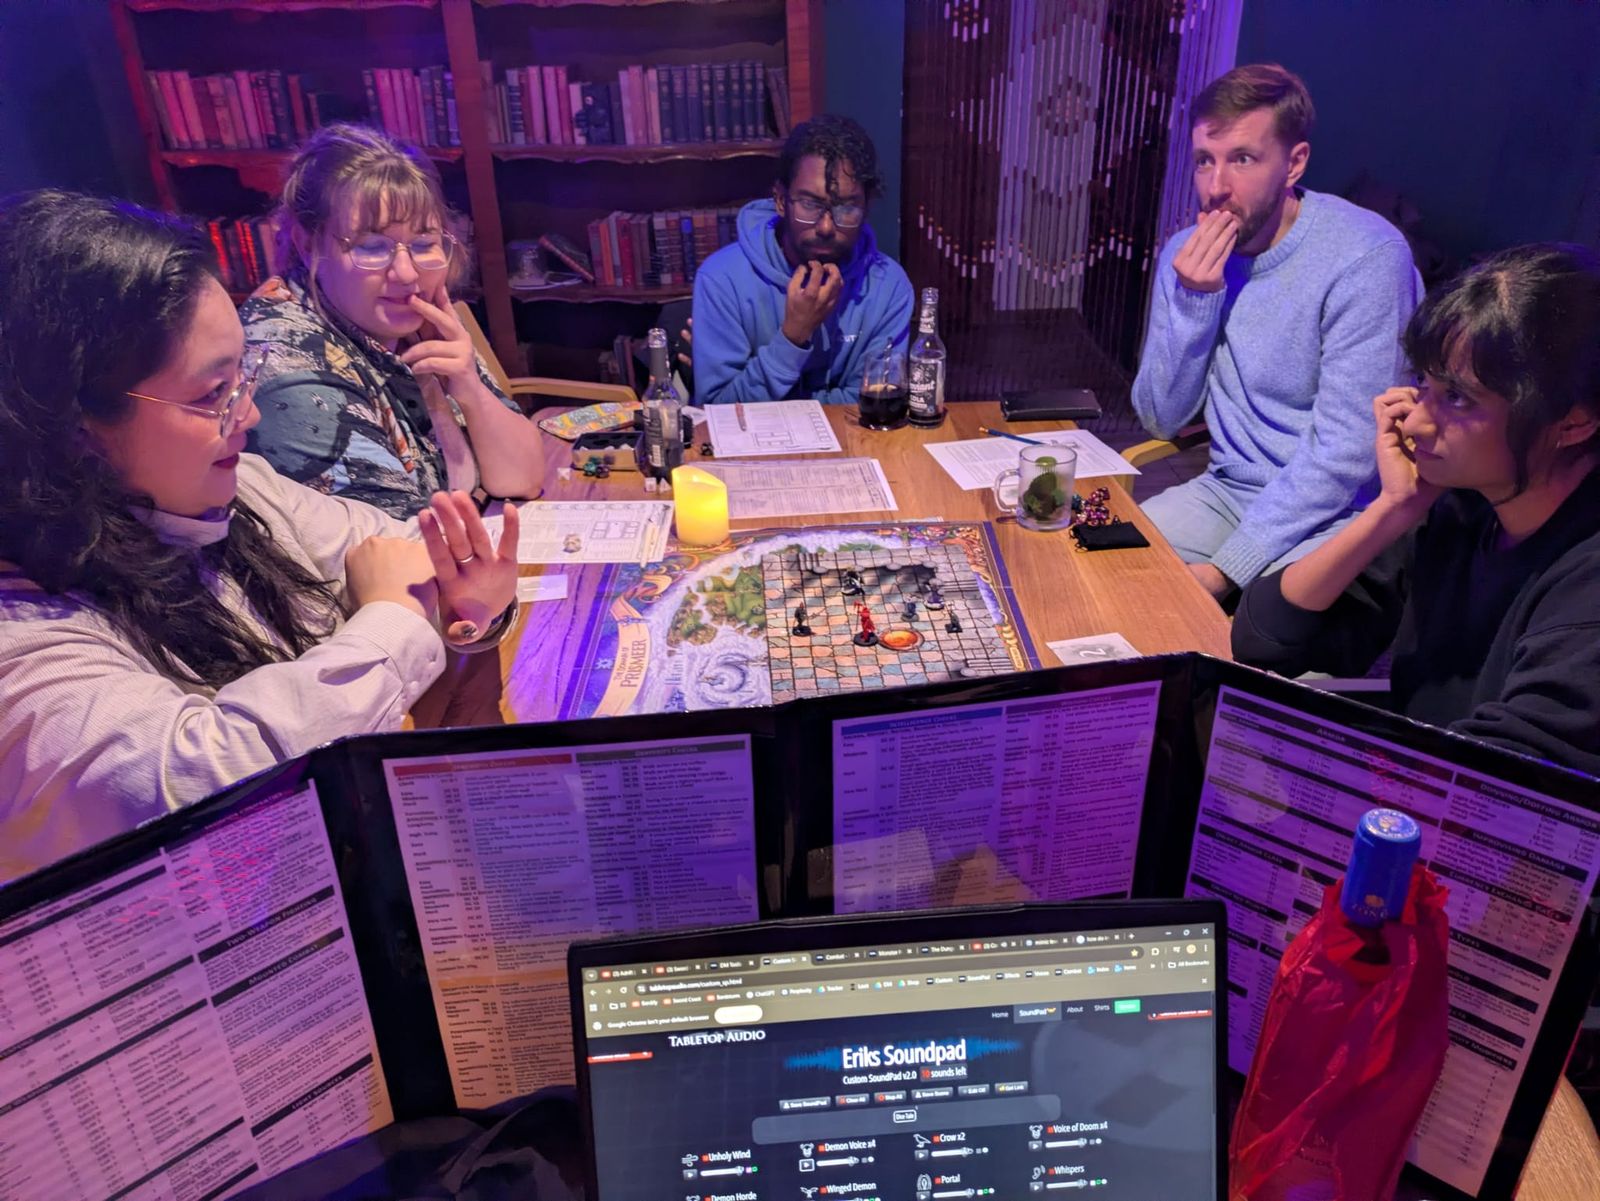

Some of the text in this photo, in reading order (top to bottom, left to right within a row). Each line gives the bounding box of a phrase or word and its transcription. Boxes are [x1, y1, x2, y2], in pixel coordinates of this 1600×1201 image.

[620, 639, 647, 687] PRISMEER
[1562, 808, 1598, 829] ARMOR
[1528, 851, 1566, 871] DAMAGE
[1018, 1007, 1047, 1017] SoundPad
[1066, 1005, 1084, 1014] About
[1094, 1003, 1110, 1012] Shirts
[991, 1011, 1009, 1019] Home
[668, 1030, 766, 1048] TABLETOP AUDIO
[842, 1037, 967, 1069] Eriks Soundpad
[842, 1070, 917, 1085] Custom SoundPad v2.0
[931, 1067, 955, 1078] sounds
[955, 1066, 967, 1076] left
[1053, 1120, 1108, 1133] Voice of Doom x4
[939, 1132, 966, 1142] Crow x2
[824, 1139, 876, 1152] Demon Voice x4
[708, 1149, 751, 1163] Unholy Wind
[1054, 1165, 1085, 1176] Whispers
[941, 1174, 961, 1184] Portal
[826, 1181, 877, 1195] Winged Demon
[711, 1191, 757, 1201] Demon Horde
